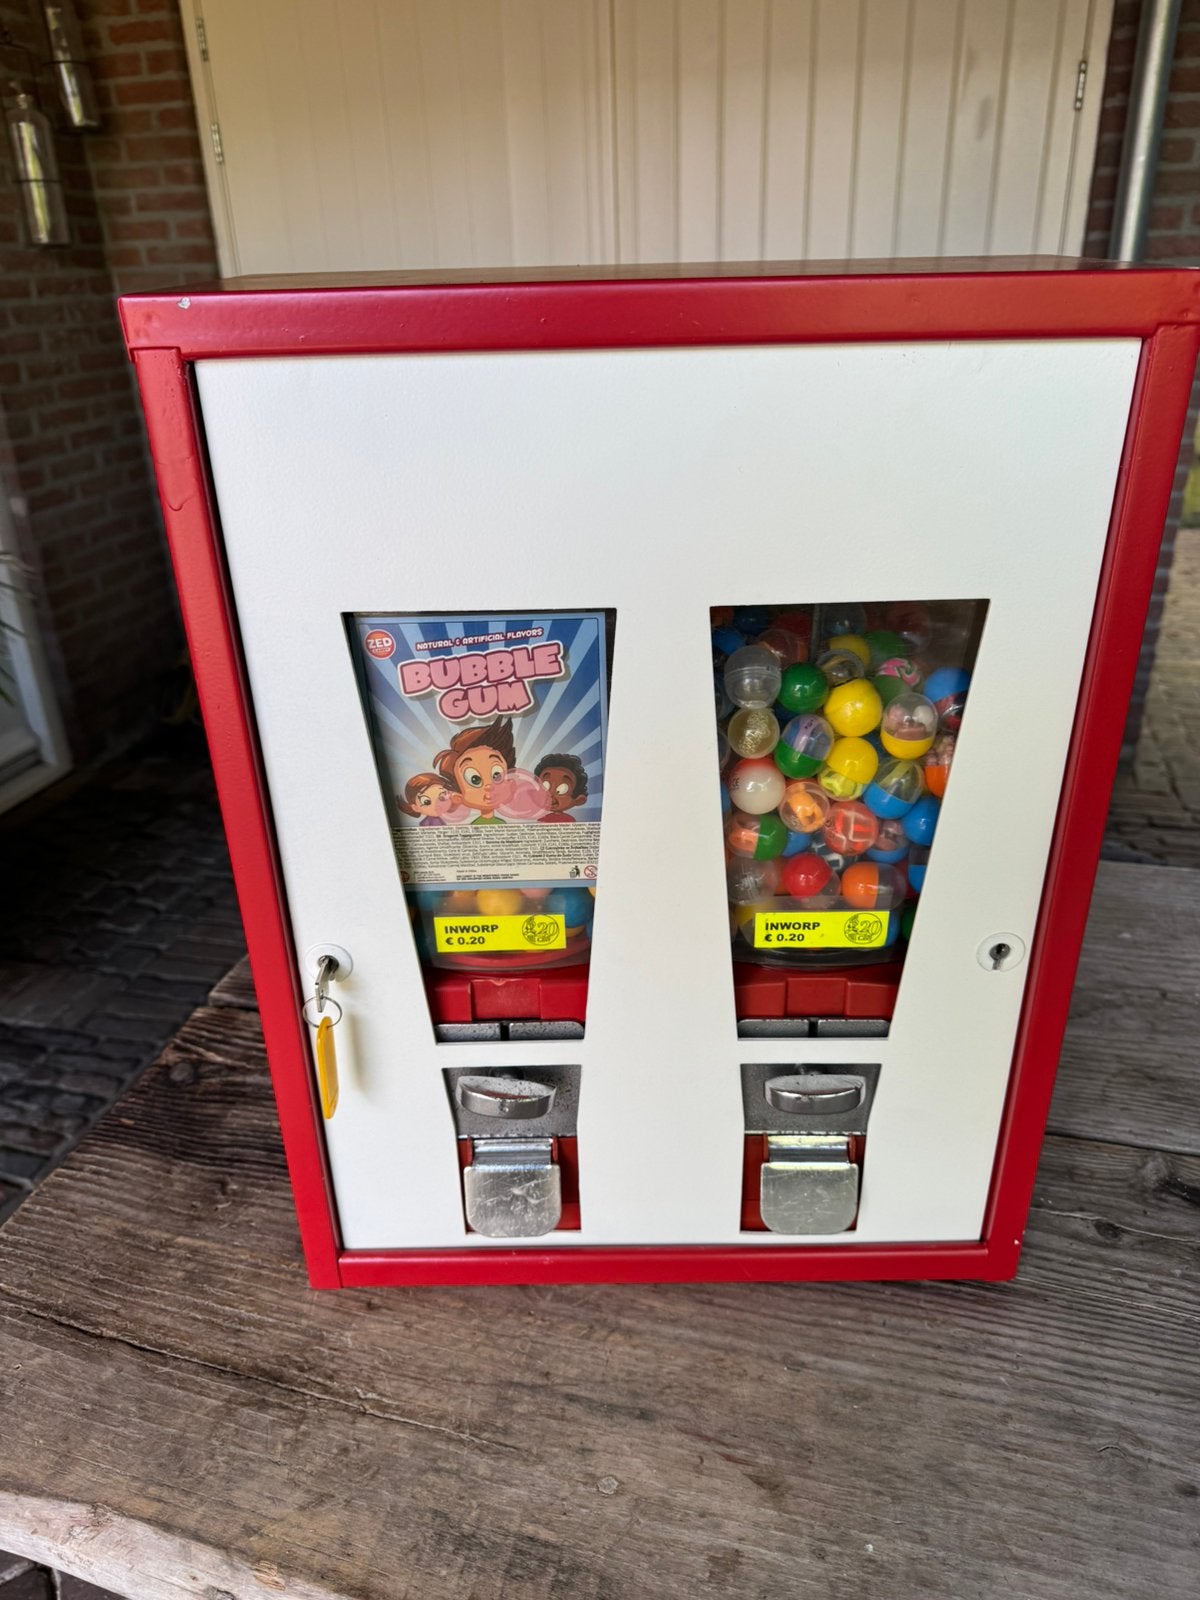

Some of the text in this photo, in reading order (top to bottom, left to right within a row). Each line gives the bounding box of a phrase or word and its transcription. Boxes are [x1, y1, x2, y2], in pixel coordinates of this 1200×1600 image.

[367, 634, 393, 649] ZED
[416, 640, 453, 650] NATURAL
[463, 634, 505, 645] ARTIFICIAL
[507, 628, 544, 639] FLAVORS
[400, 642, 563, 695] BUBBLE
[438, 679, 532, 720] GUM
[444, 924, 499, 934] INWORP
[765, 922, 820, 931] INWORP
[446, 936, 486, 945] € 0.20
[764, 933, 805, 942] € 0.20
